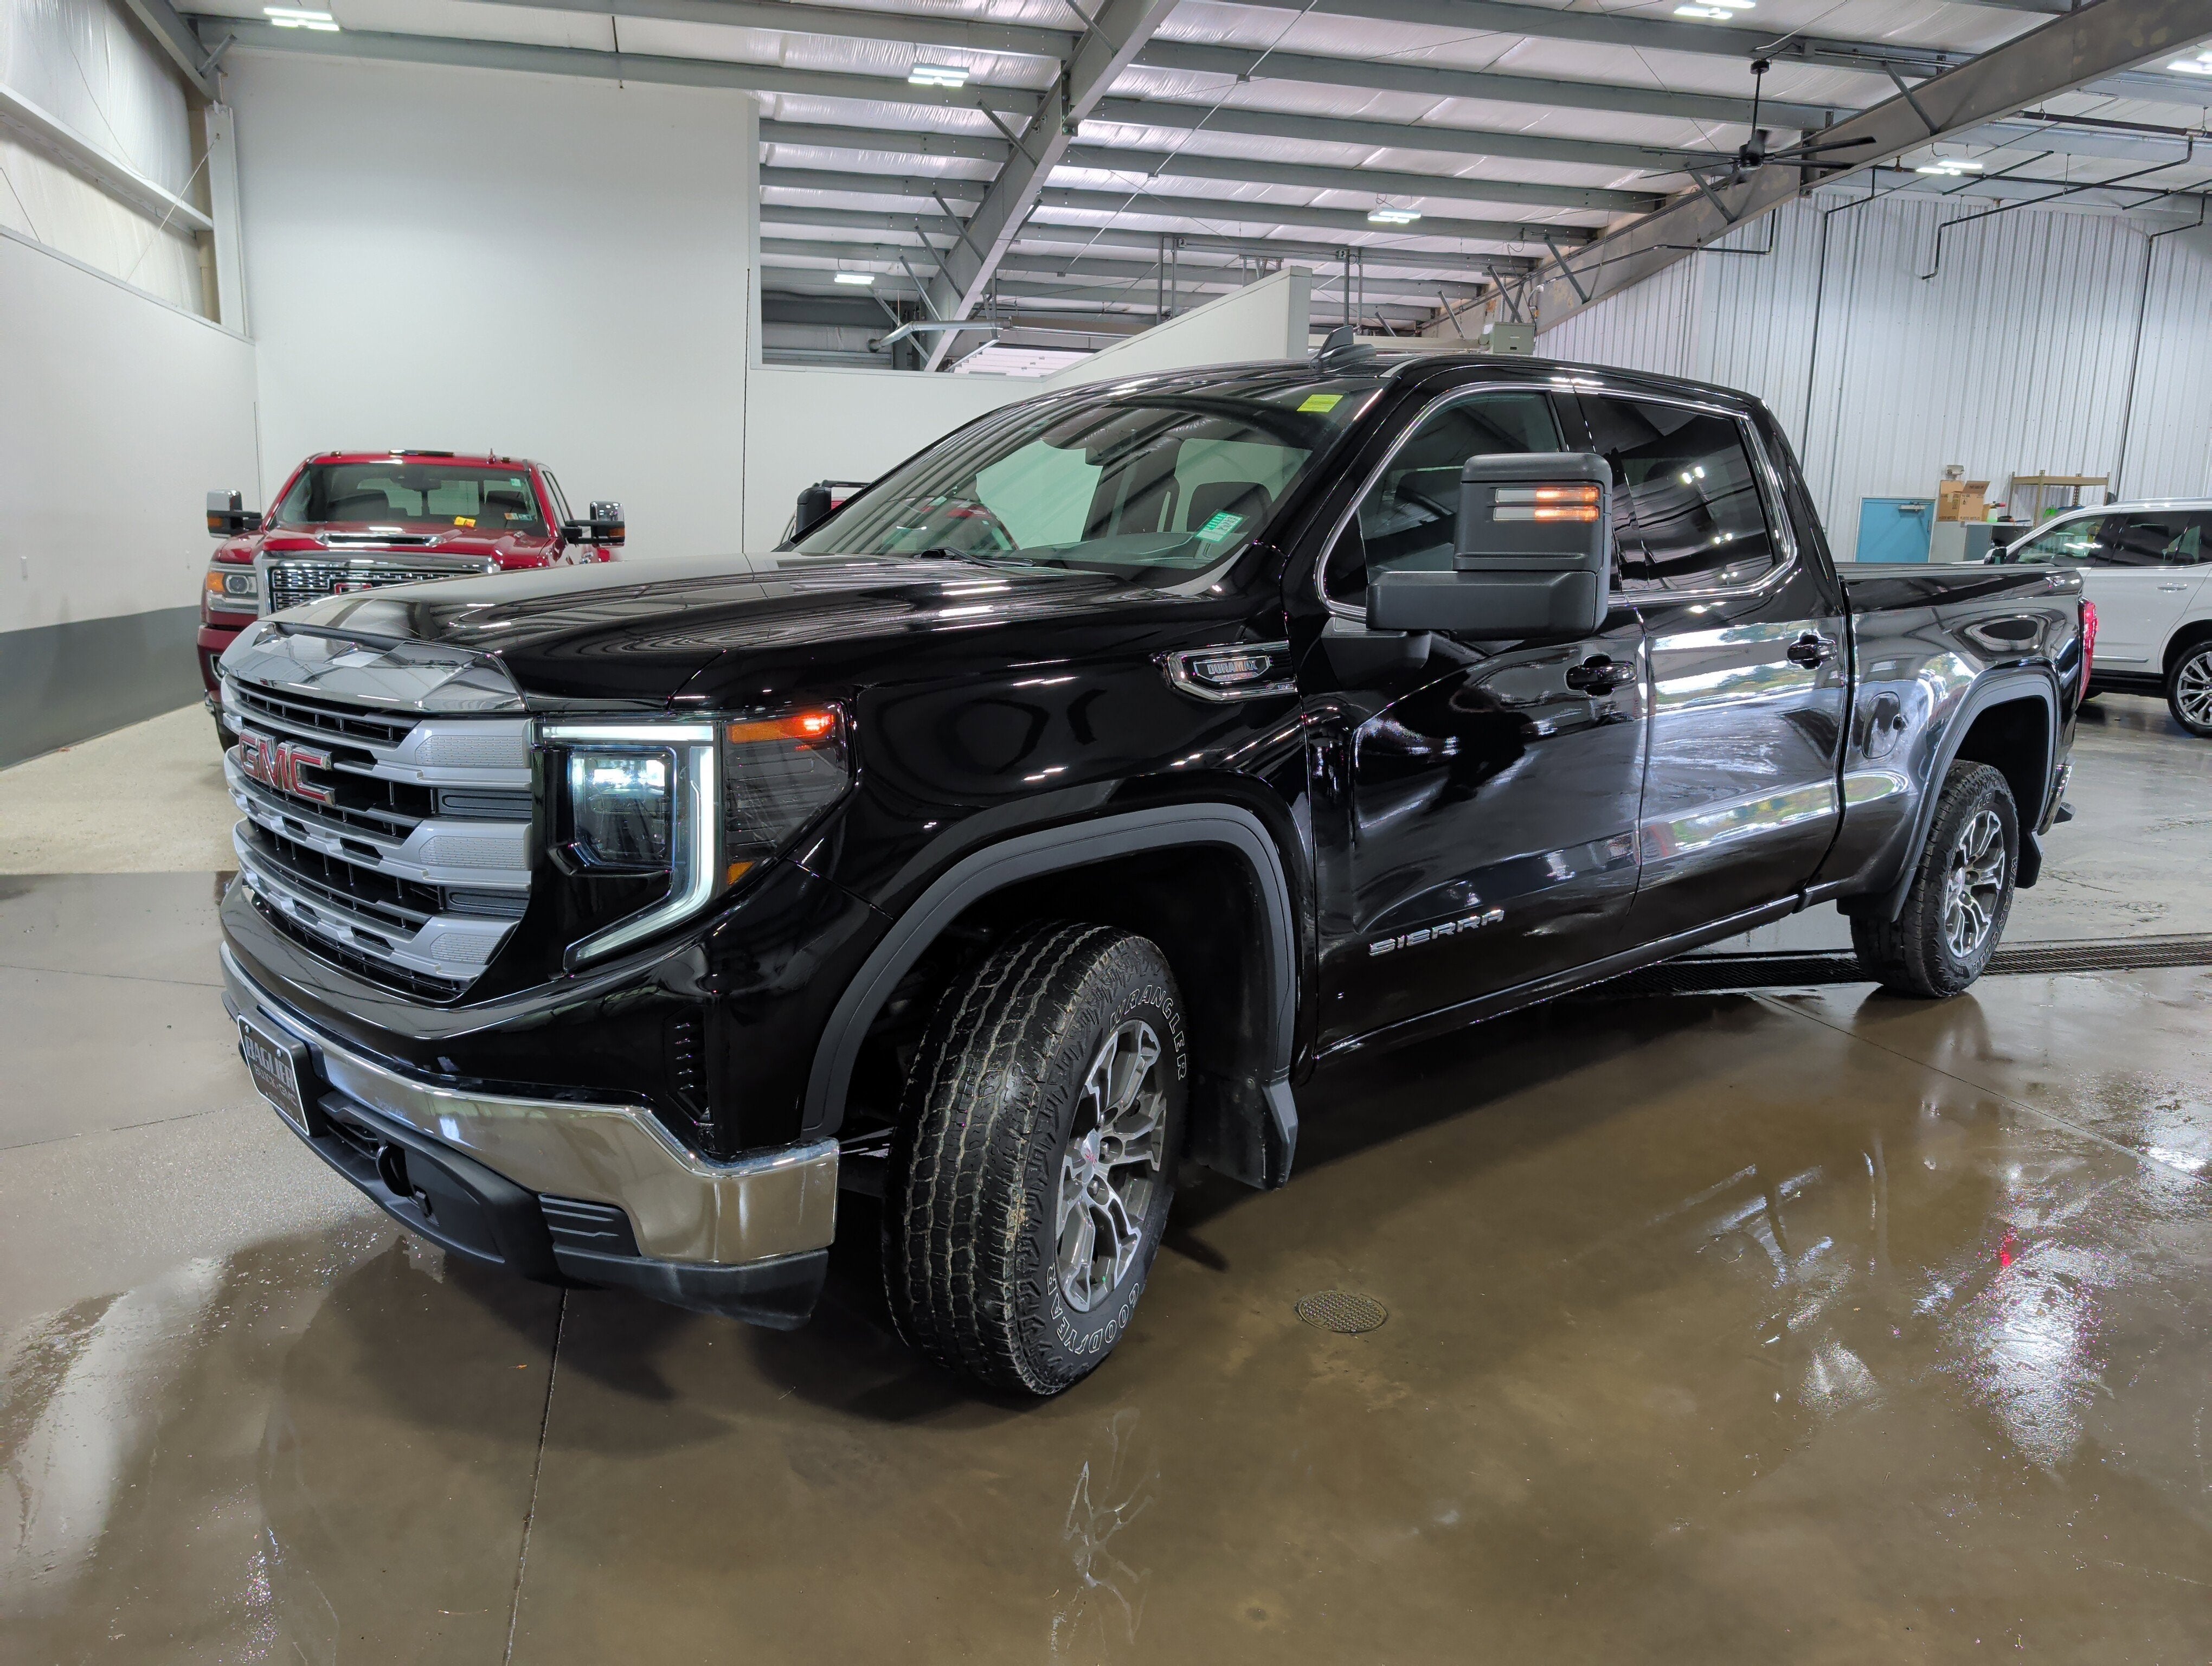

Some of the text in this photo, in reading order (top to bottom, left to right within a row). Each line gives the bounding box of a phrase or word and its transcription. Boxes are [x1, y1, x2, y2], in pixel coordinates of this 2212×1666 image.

[1207, 659, 1258, 675] DURAMAX
[239, 728, 336, 806] GMC
[1368, 909, 1505, 957] SIERRA
[1109, 985, 1187, 1081] WRANGLER
[1046, 1262, 1139, 1355] GOODYEAR
